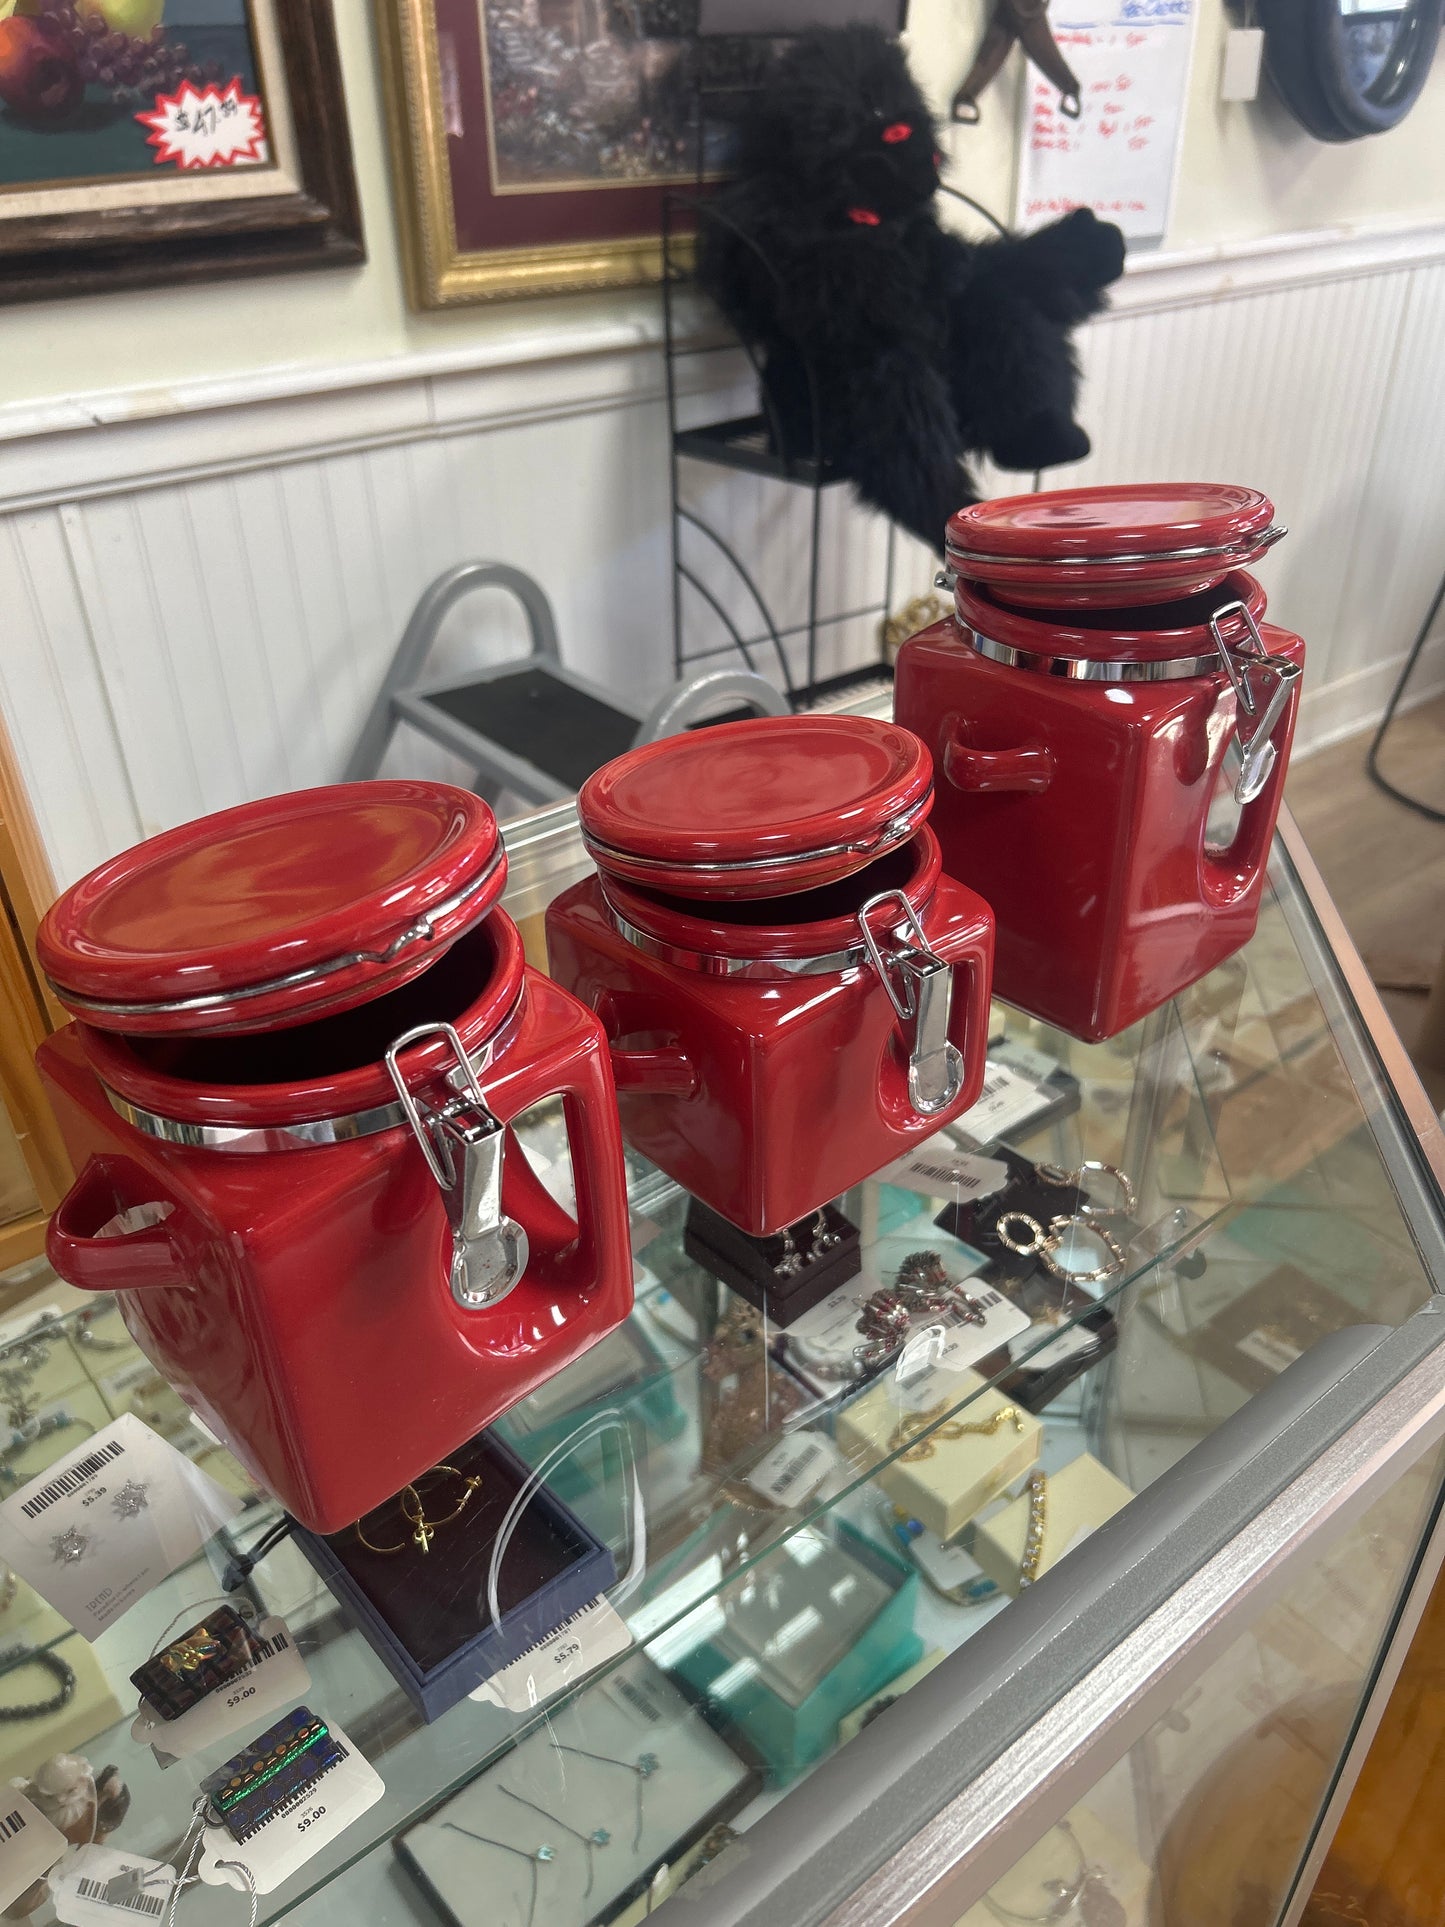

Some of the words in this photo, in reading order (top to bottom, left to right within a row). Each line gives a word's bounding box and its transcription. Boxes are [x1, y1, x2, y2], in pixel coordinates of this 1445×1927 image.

[82, 1487, 107, 1506] $5.39
[554, 1643, 579, 1664] $5.79
[227, 1687, 256, 1707] $9.00
[297, 1806, 326, 1832] $9.00
